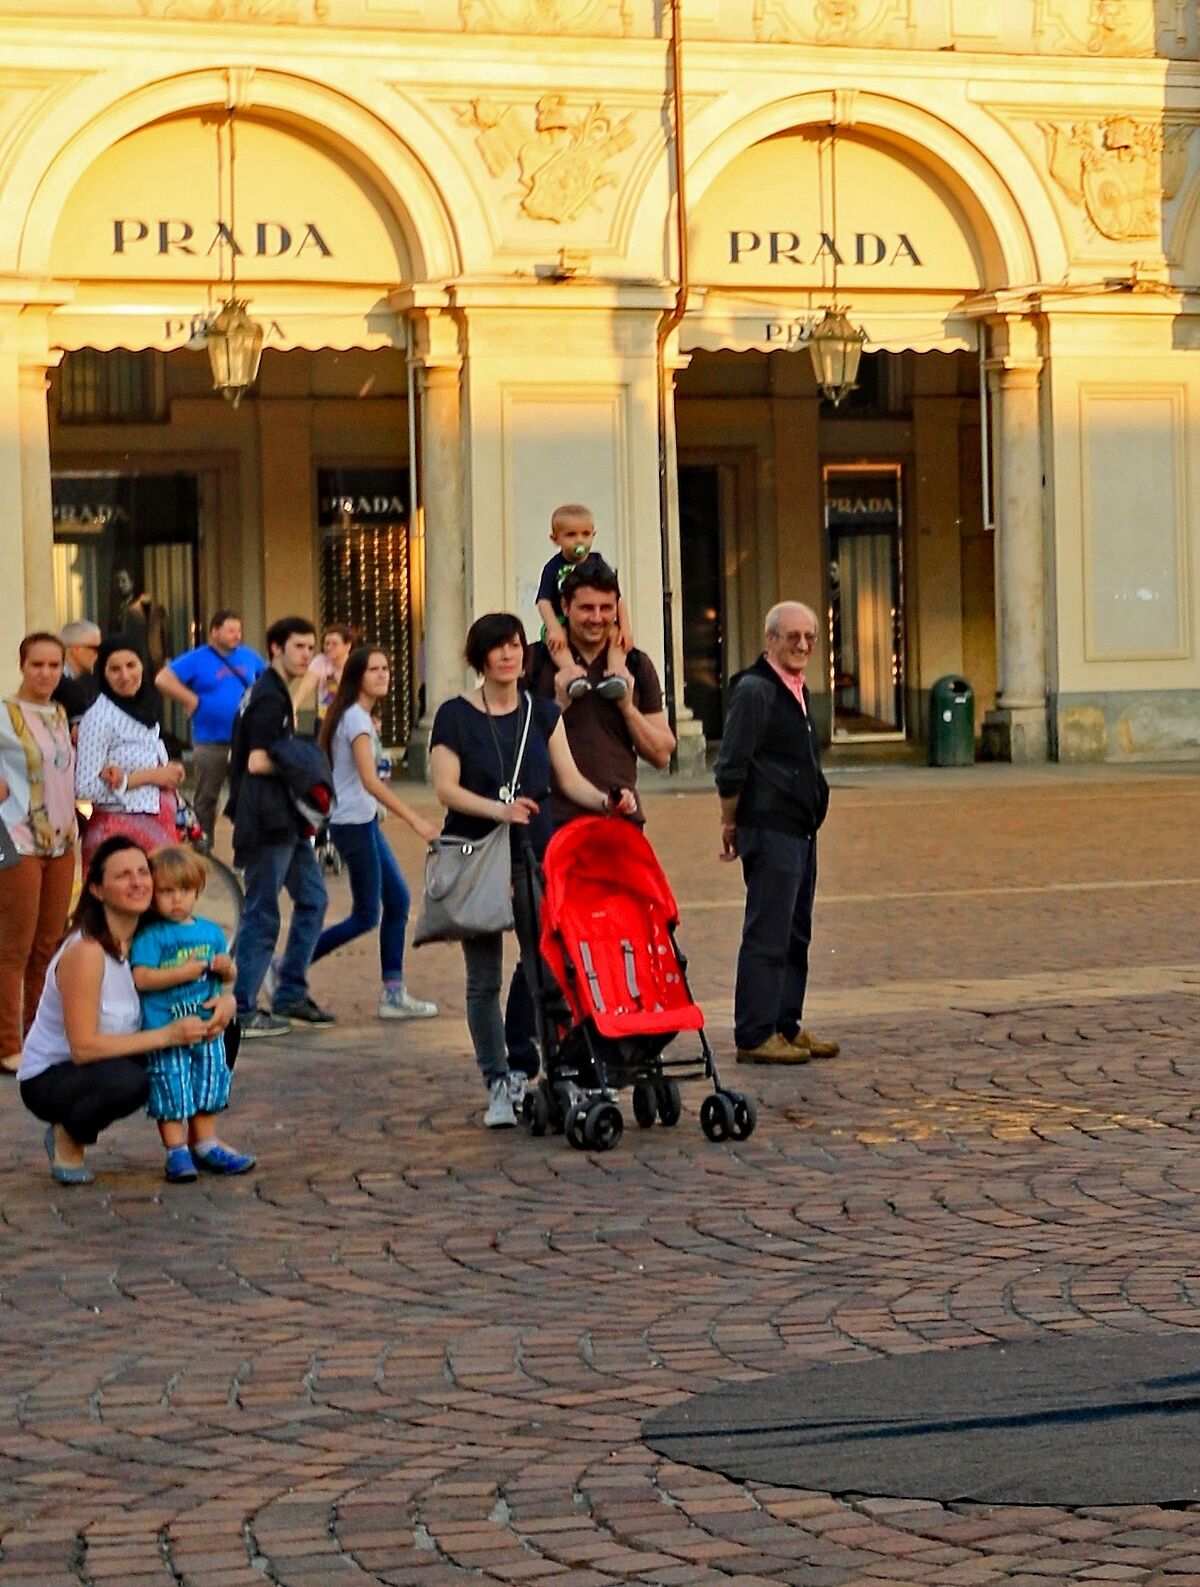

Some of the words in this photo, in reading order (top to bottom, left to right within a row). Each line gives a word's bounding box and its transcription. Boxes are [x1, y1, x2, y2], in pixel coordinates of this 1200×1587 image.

[113, 219, 334, 257] PRADA
[729, 231, 924, 266] PRADA
[165, 318, 286, 340] PRA
[765, 323, 871, 342] PRA
